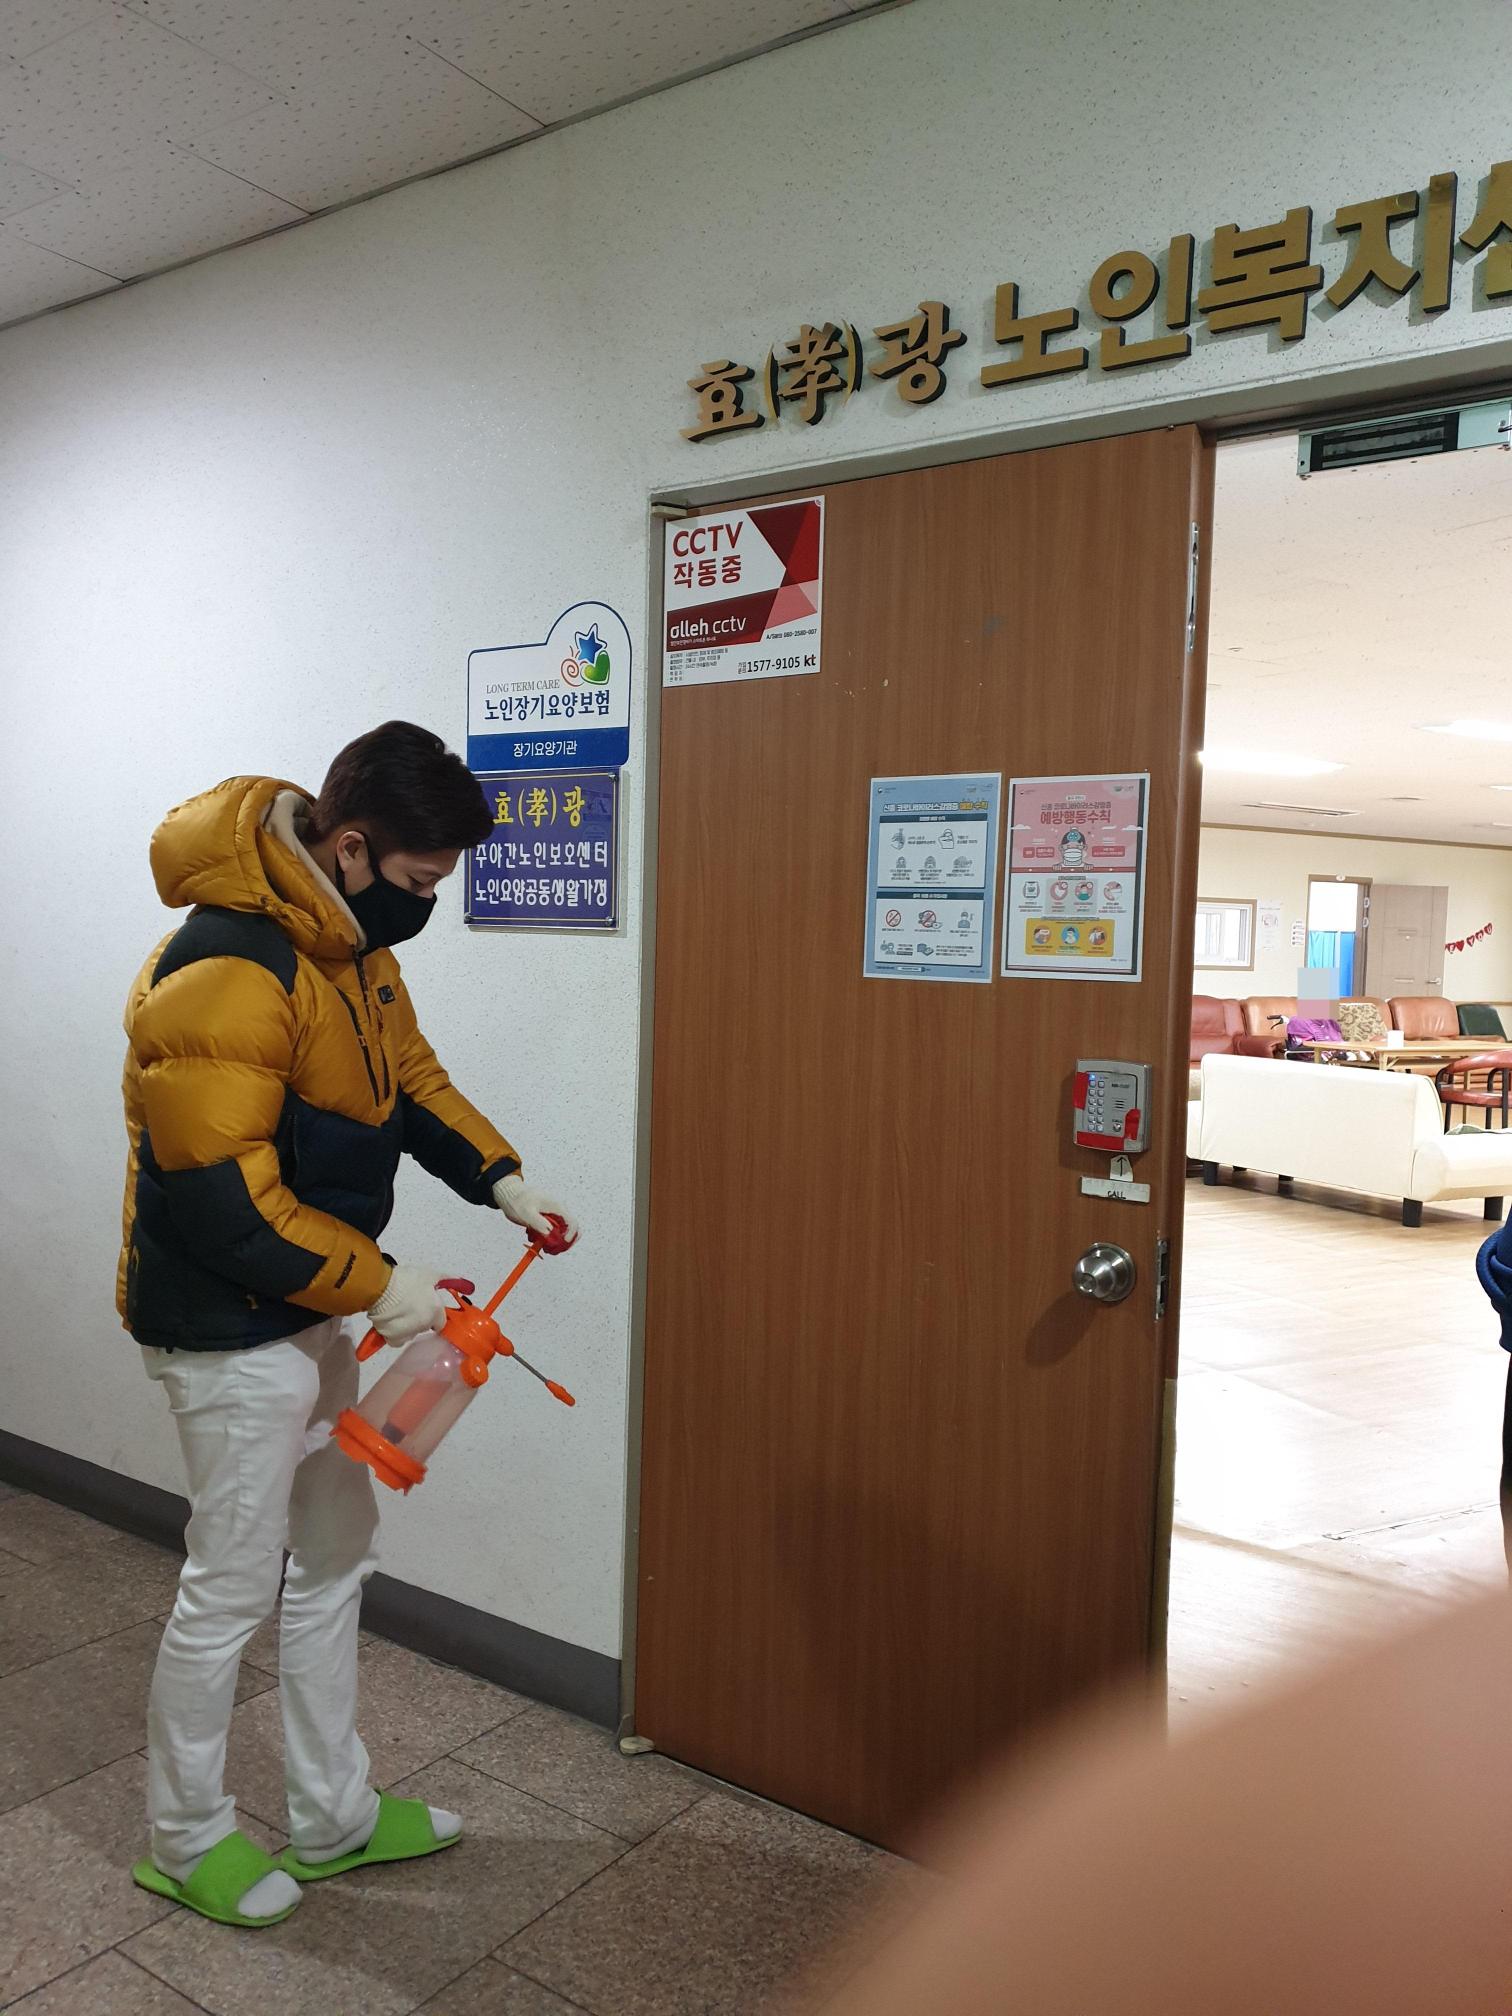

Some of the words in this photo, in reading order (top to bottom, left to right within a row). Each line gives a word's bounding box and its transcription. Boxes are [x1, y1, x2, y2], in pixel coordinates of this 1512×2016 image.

[672, 521, 744, 557] CCTV
[673, 554, 742, 589] 작동중
[670, 618, 709, 639] olleh
[712, 615, 747, 634] cctv
[747, 656, 800, 673] 1577-9105
[804, 654, 817, 667] kt
[486, 683, 509, 694] LONG
[511, 681, 535, 692] TERM
[536, 679, 561, 690] CARE
[484, 690, 610, 721] 노인장기요양보험
[513, 740, 578, 757] 장기요양기관
[1040, 809, 1112, 825] 예방행동수칙
[475, 841, 608, 868] 주야간노인보호센터
[475, 878, 608, 907] 노인요양공동생활가정
